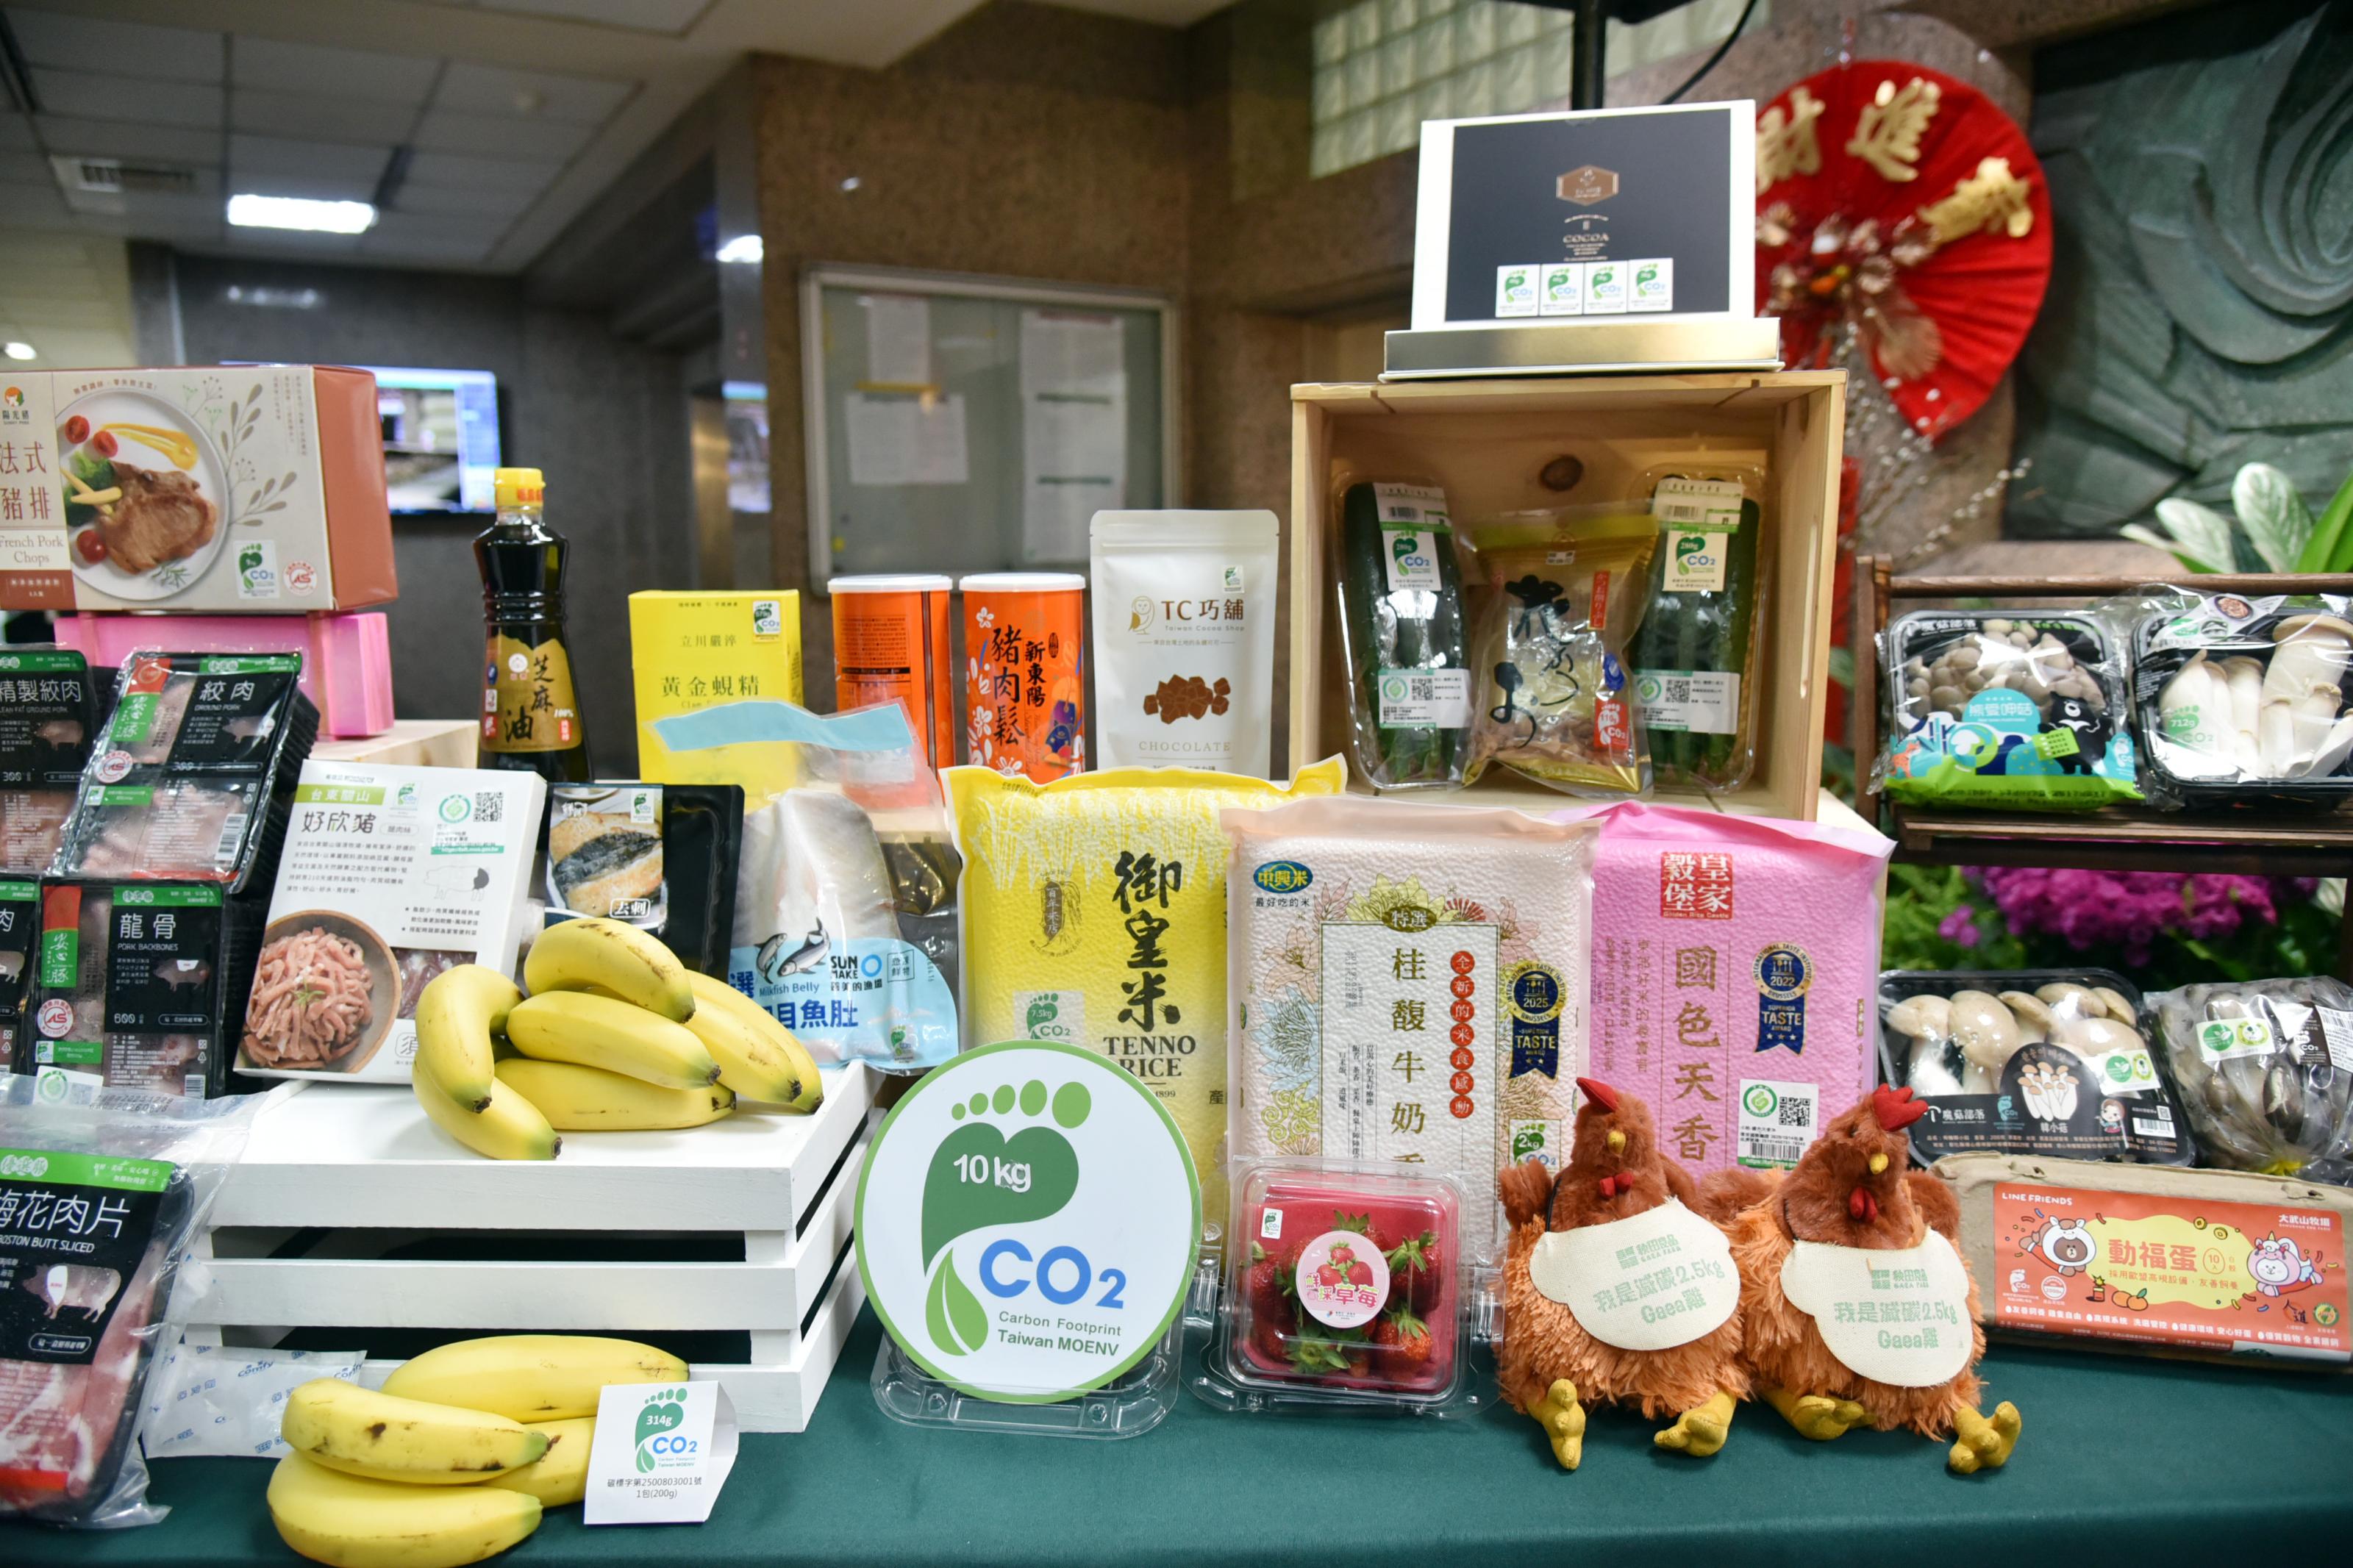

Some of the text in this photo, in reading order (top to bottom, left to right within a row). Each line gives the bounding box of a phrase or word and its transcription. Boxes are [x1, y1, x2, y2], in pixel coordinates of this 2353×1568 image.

[1563, 233, 1609, 243] COCOA
[0, 441, 47, 475] 法式
[0, 486, 51, 521] 豬排
[38, 535, 63, 548] Pork
[1679, 542, 1699, 551] 280g
[13, 551, 50, 565] Chops
[1404, 556, 1429, 567] CO2
[1687, 555, 1715, 565] CO2
[1161, 600, 1192, 621] TC
[1226, 625, 1245, 633] Shop
[1024, 640, 1046, 708] 新東陽
[199, 680, 255, 701] 絞肉
[661, 675, 760, 698] 黃金蜆精
[991, 624, 1024, 747] 豬肉鬆
[2170, 719, 2195, 728] 712g
[1608, 726, 1627, 739] CO2
[1138, 741, 1232, 752] CHOCOLATE
[3, 772, 21, 781] 300
[301, 810, 376, 834] 好欣豬
[1257, 870, 1309, 887] 中興米
[613, 900, 648, 915] 去刺
[1255, 897, 1311, 908] 最好吃的米
[1046, 887, 1060, 934] 百年米店
[1707, 912, 1729, 920] Castle
[119, 912, 176, 940] 龍骨
[1391, 910, 1428, 928] 特選
[118, 943, 179, 951] PORK BACKBONES
[1111, 850, 1182, 1033] 御皇米
[830, 955, 859, 969] SUN
[1770, 976, 1795, 987] 2022
[759, 982, 820, 997] Milkfish Belly
[1767, 989, 1797, 999] BRUSSELS
[1523, 997, 1549, 1009] 2025
[114, 1014, 135, 1025] 600
[1032, 1009, 1052, 1019] 7.5kg
[1521, 1012, 1552, 1023] BRUSSELS
[1761, 1011, 1802, 1025] TASTE
[1040, 1024, 1071, 1037] CO2
[1452, 953, 1473, 1117] 全新的米食感動
[1103, 1035, 1196, 1056] TENNO
[1515, 1035, 1557, 1049] TASTE
[1390, 947, 1427, 1164] 桂馥牛奶
[1668, 945, 1721, 1162] 國色天香
[1120, 1059, 1182, 1078] RICE
[1518, 1134, 1540, 1149] 2kg
[954, 1154, 1032, 1193] 10 kg
[2002, 1192, 2073, 1206] LINE FRIENDS
[2278, 1214, 2331, 1227] 大武山牧場
[32, 1236, 59, 1250] BUTT
[59, 1240, 95, 1253] SLICED
[2108, 1238, 2199, 1273] 動福蛋
[2208, 1254, 2220, 1264] 10
[979, 1238, 1127, 1309] CO2
[1640, 1286, 1707, 1324] Gaea雞
[1833, 1299, 1958, 1325] 我是減碳2.5kg
[999, 1311, 1122, 1338] Carbon Footprint
[1877, 1326, 1939, 1350] Gaea雞
[2216, 1326, 2252, 1339] 安心好蛋
[998, 1329, 1120, 1357] Taiwan MOENV
[646, 1414, 673, 1427] 314g
[652, 1436, 698, 1455] CO2
[636, 1489, 678, 1500] 1包(200g)
